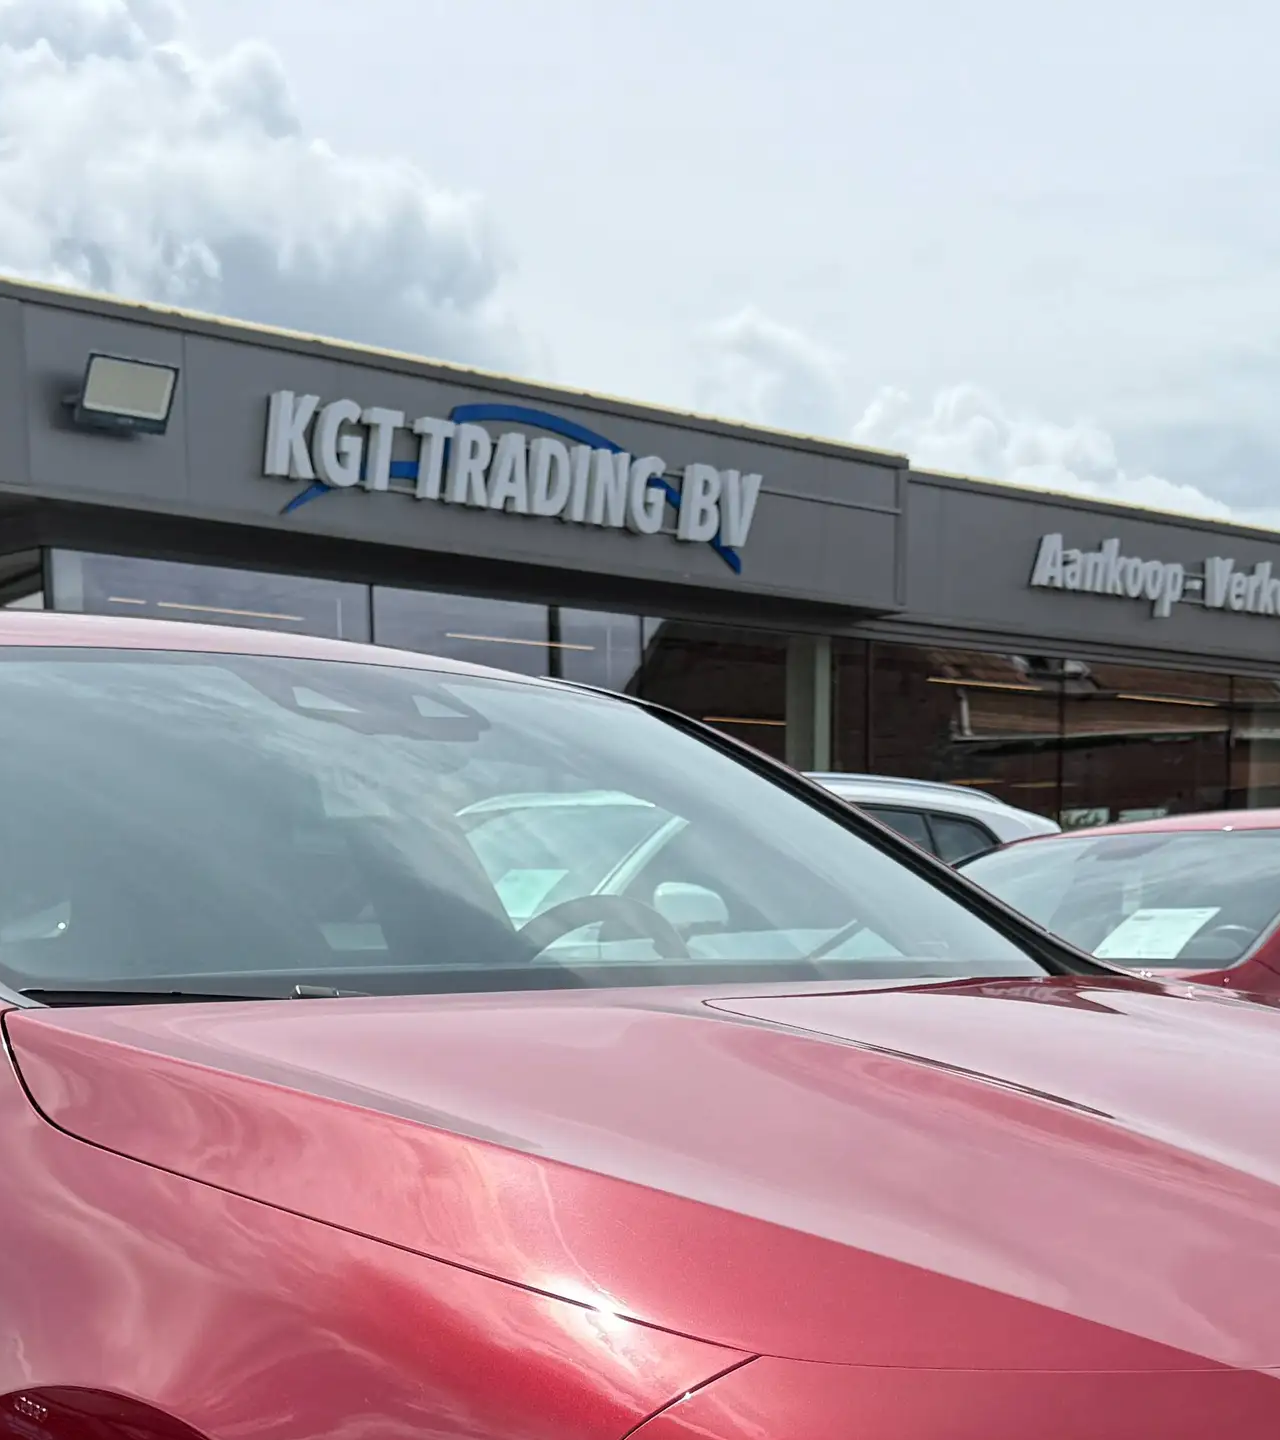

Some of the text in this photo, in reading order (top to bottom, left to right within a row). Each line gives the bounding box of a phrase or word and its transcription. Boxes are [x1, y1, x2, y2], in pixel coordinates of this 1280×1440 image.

[264, 390, 763, 548] KGT TRADING BV
[1030, 532, 1185, 618] Aankoop
